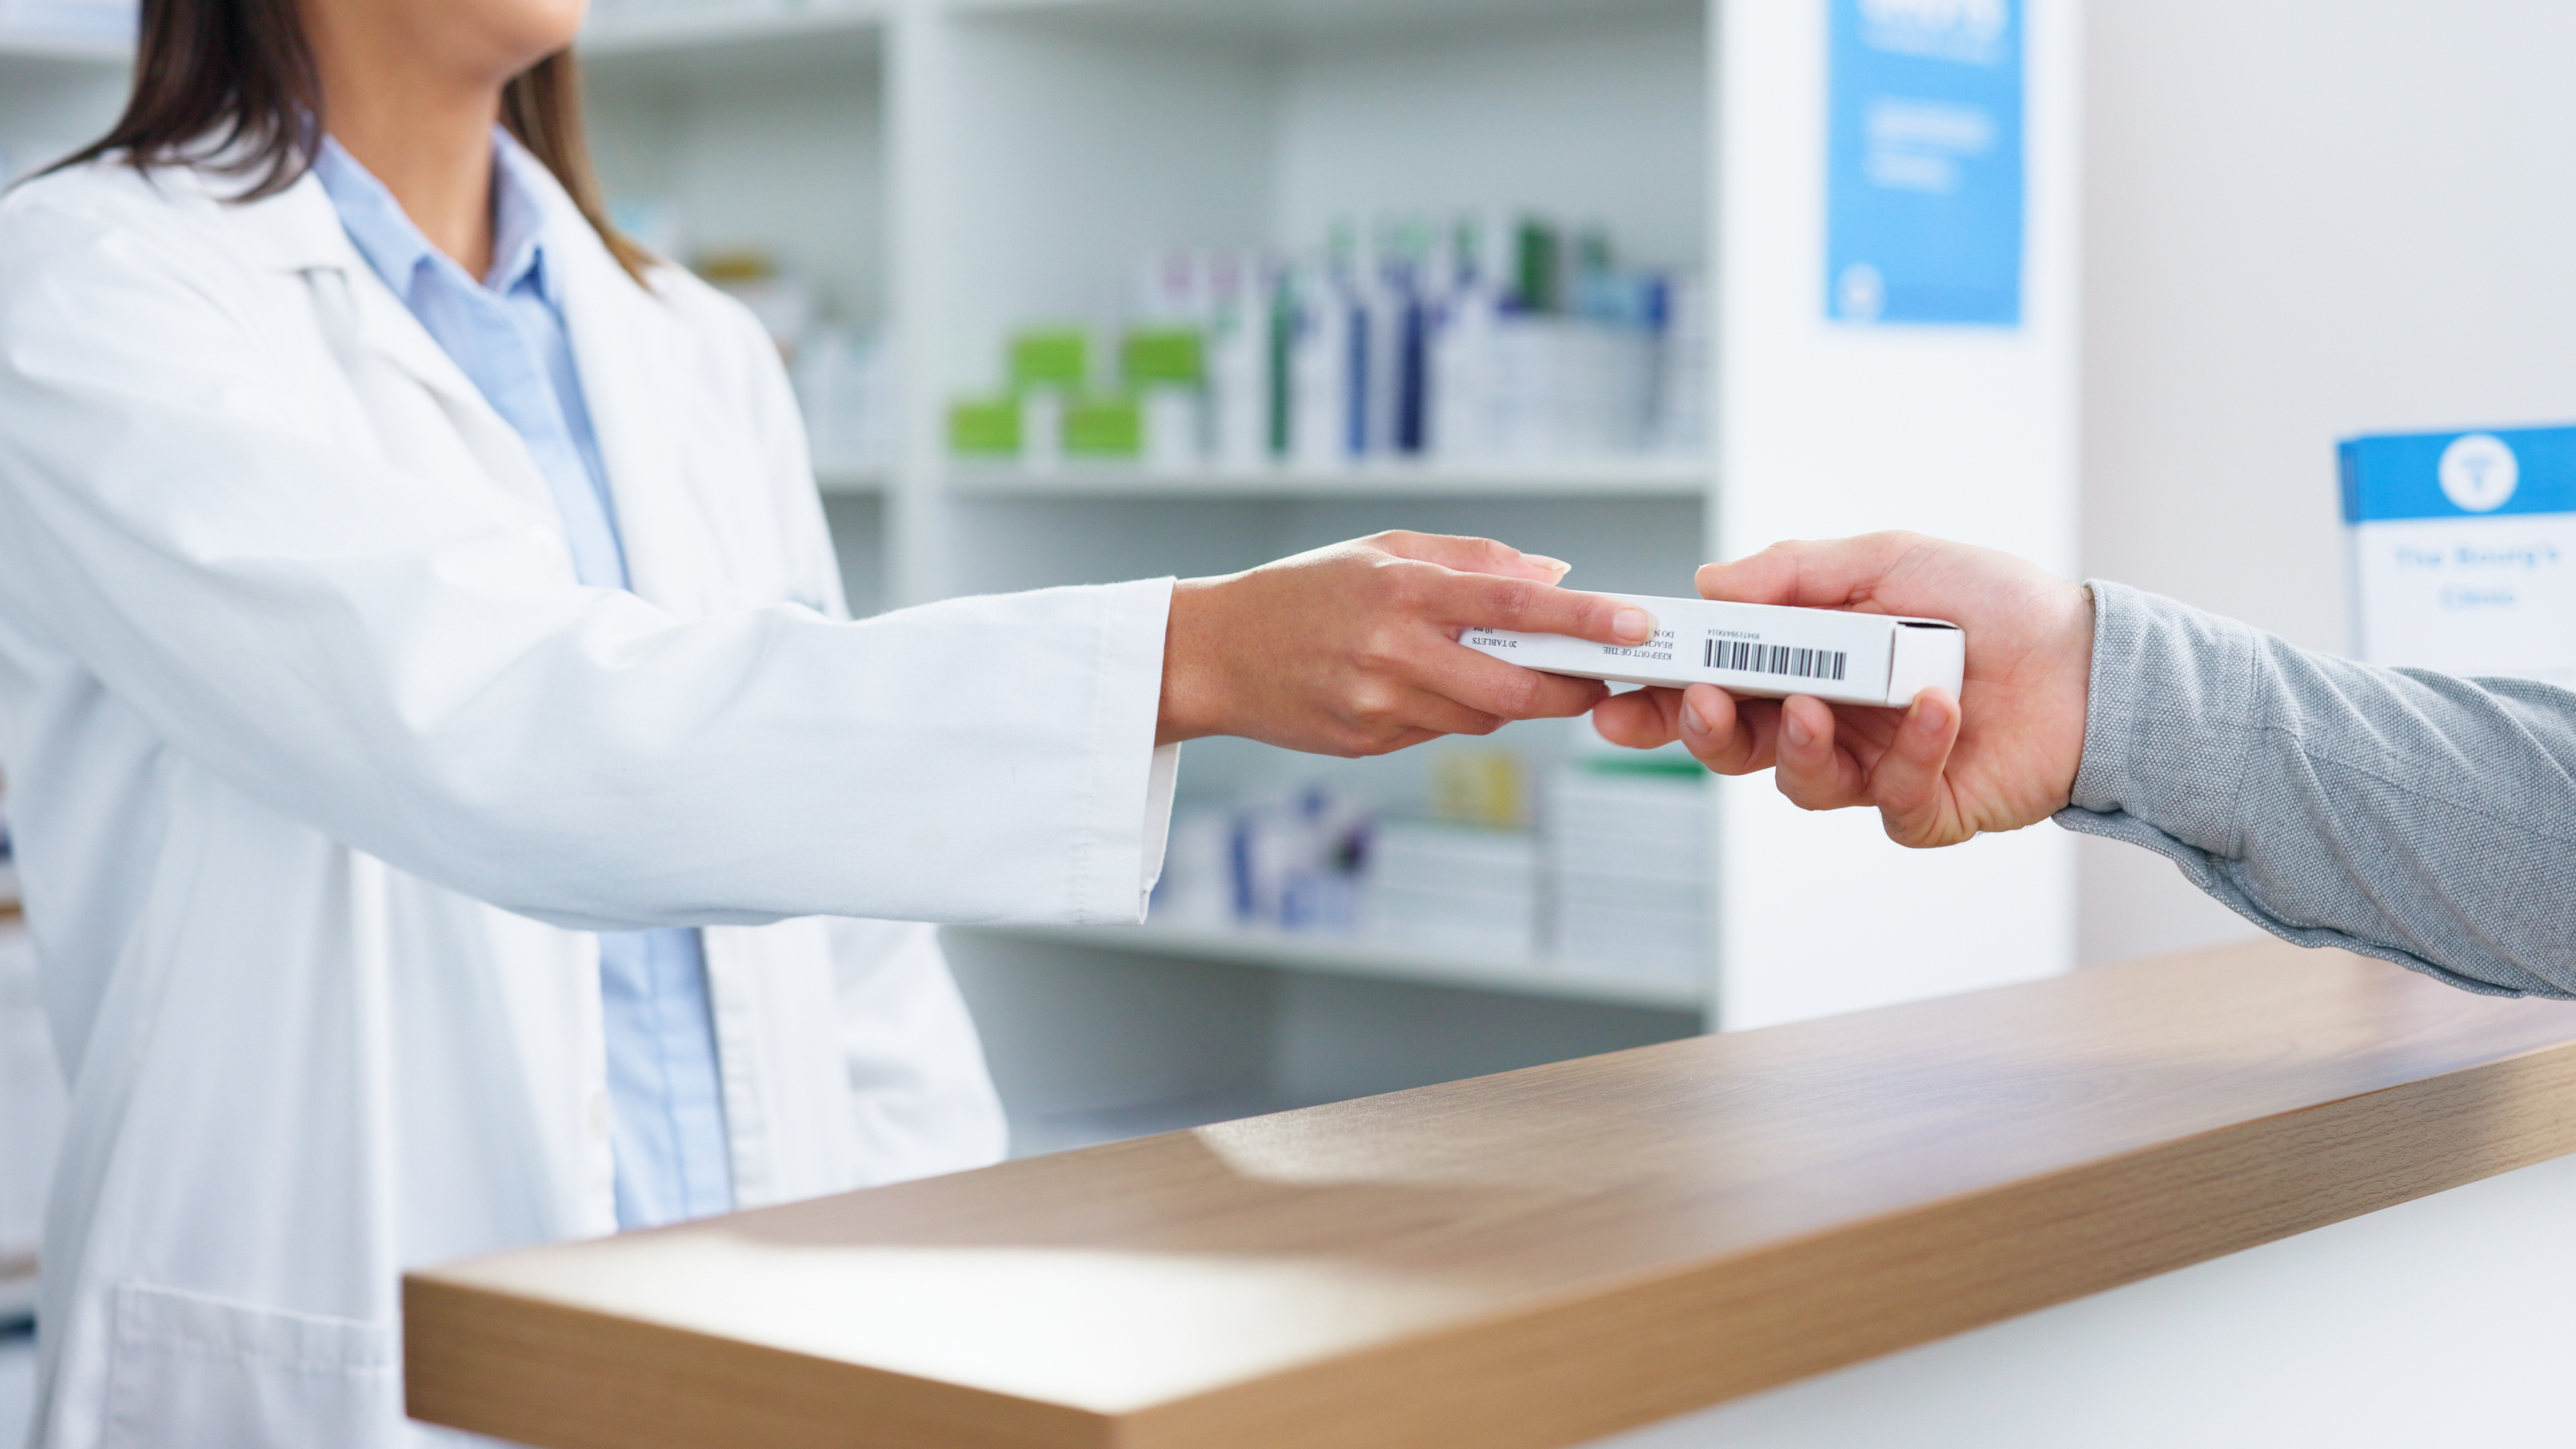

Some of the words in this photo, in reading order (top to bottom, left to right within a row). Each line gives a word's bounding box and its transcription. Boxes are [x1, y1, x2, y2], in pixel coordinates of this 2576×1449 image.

[1472, 637, 1507, 647] TABLETS
[1646, 640, 1674, 649] REACH
[1603, 646, 1619, 655] THE
[1620, 648, 1631, 656] OF
[1633, 650, 1650, 658] OUT
[1651, 652, 1672, 661] KEEP
